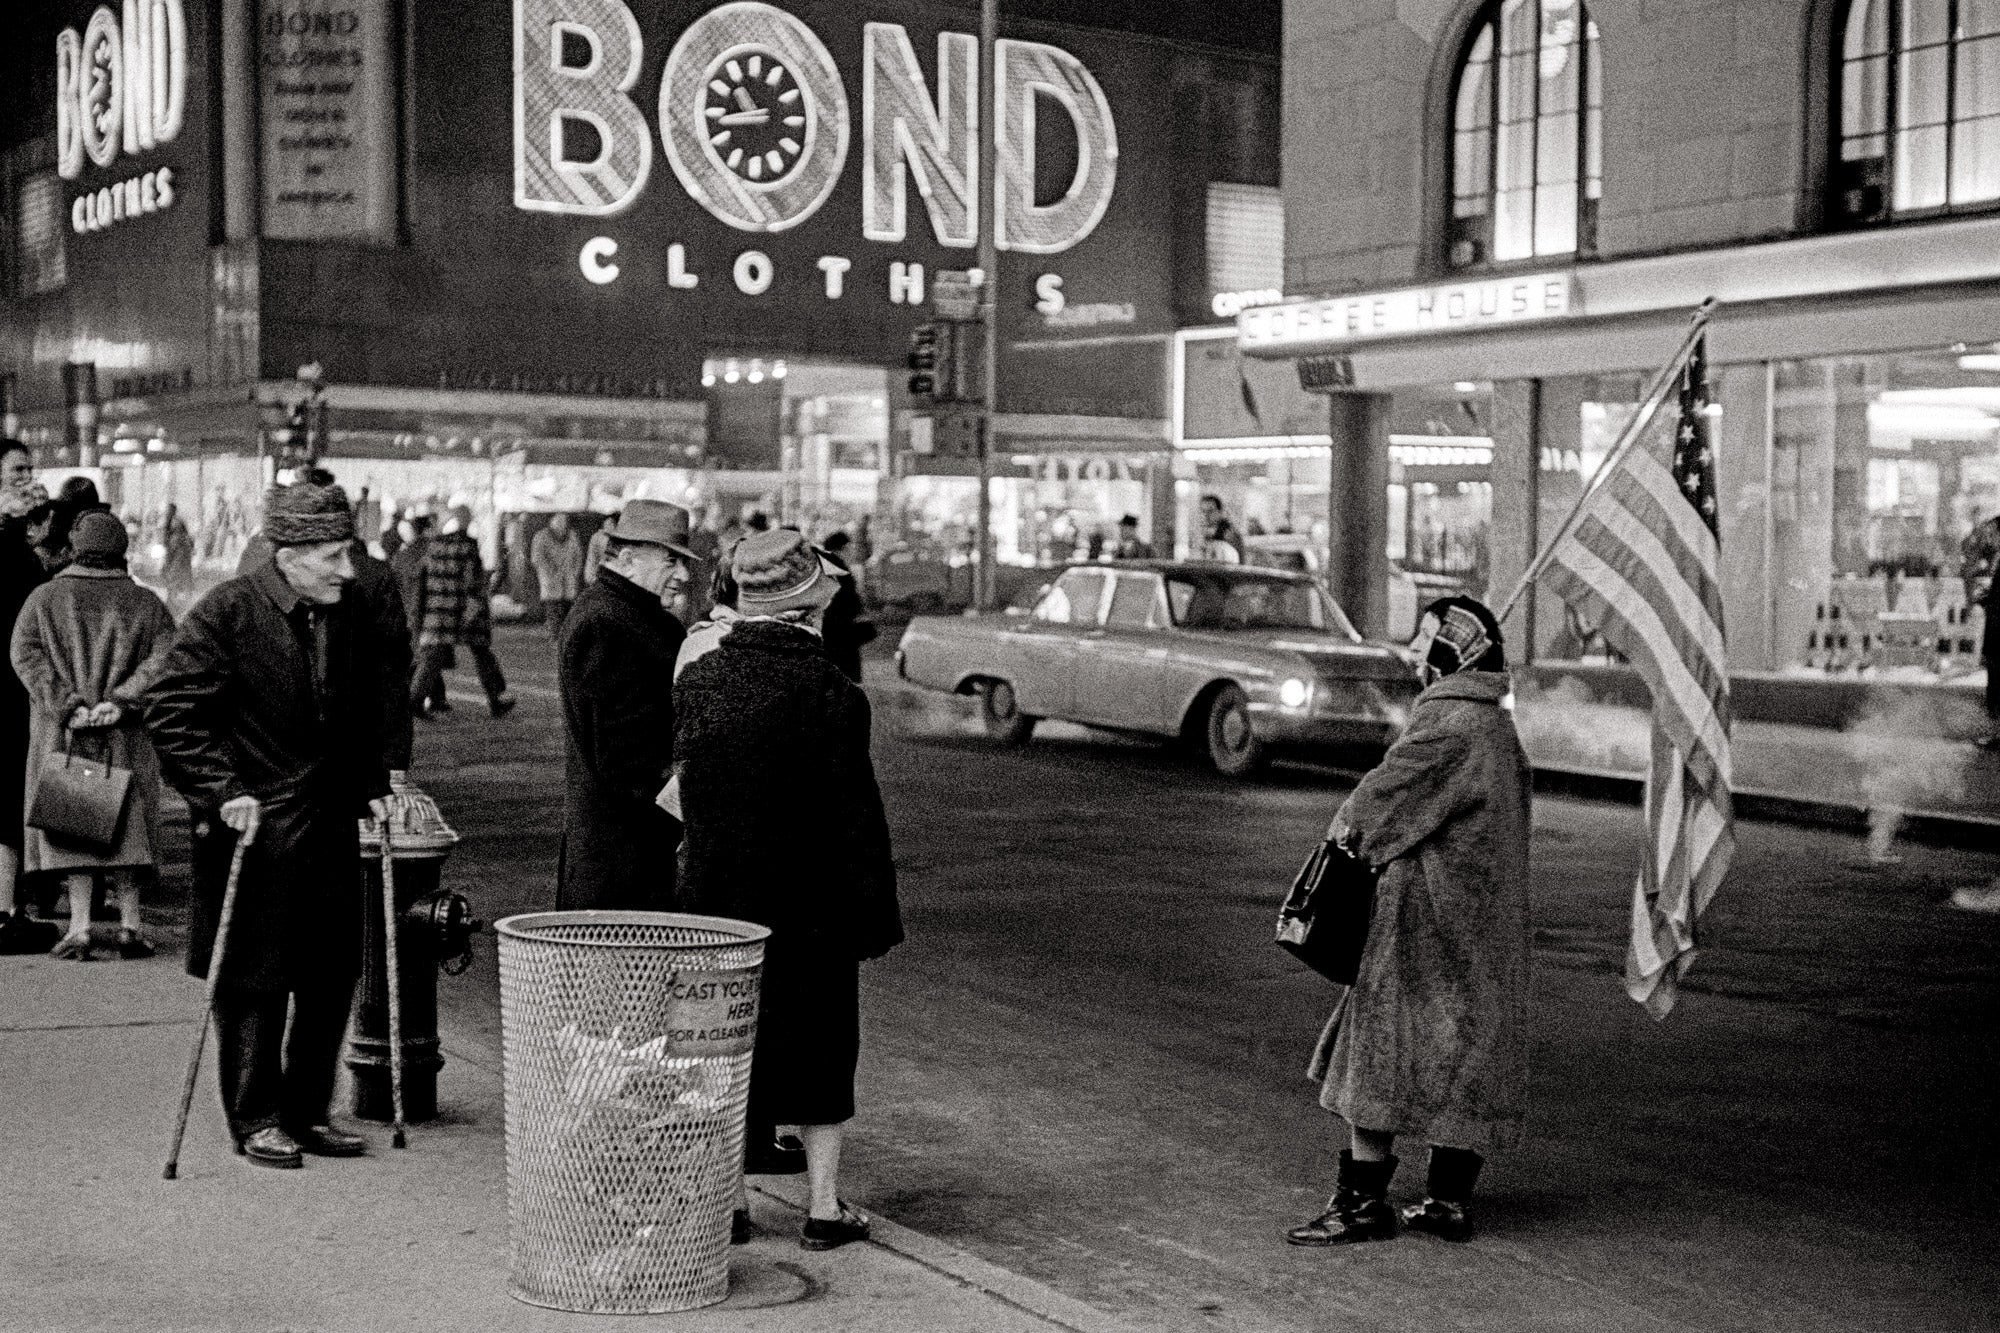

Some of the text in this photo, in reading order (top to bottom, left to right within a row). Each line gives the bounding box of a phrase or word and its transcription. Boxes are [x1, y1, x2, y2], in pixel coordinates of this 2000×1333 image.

[266, 10, 359, 36] BOND
[56, 0, 187, 179] BOND
[513, 0, 1117, 254] BOND
[72, 166, 173, 234] CLOTHES
[579, 236, 1065, 315] CLOTHS
[1244, 301, 1385, 340] COFFEE
[1418, 281, 1561, 328] HOUSE
[672, 982, 717, 1000] CAST
[668, 1029, 694, 1041] FOR
[698, 1029, 706, 1040] A
